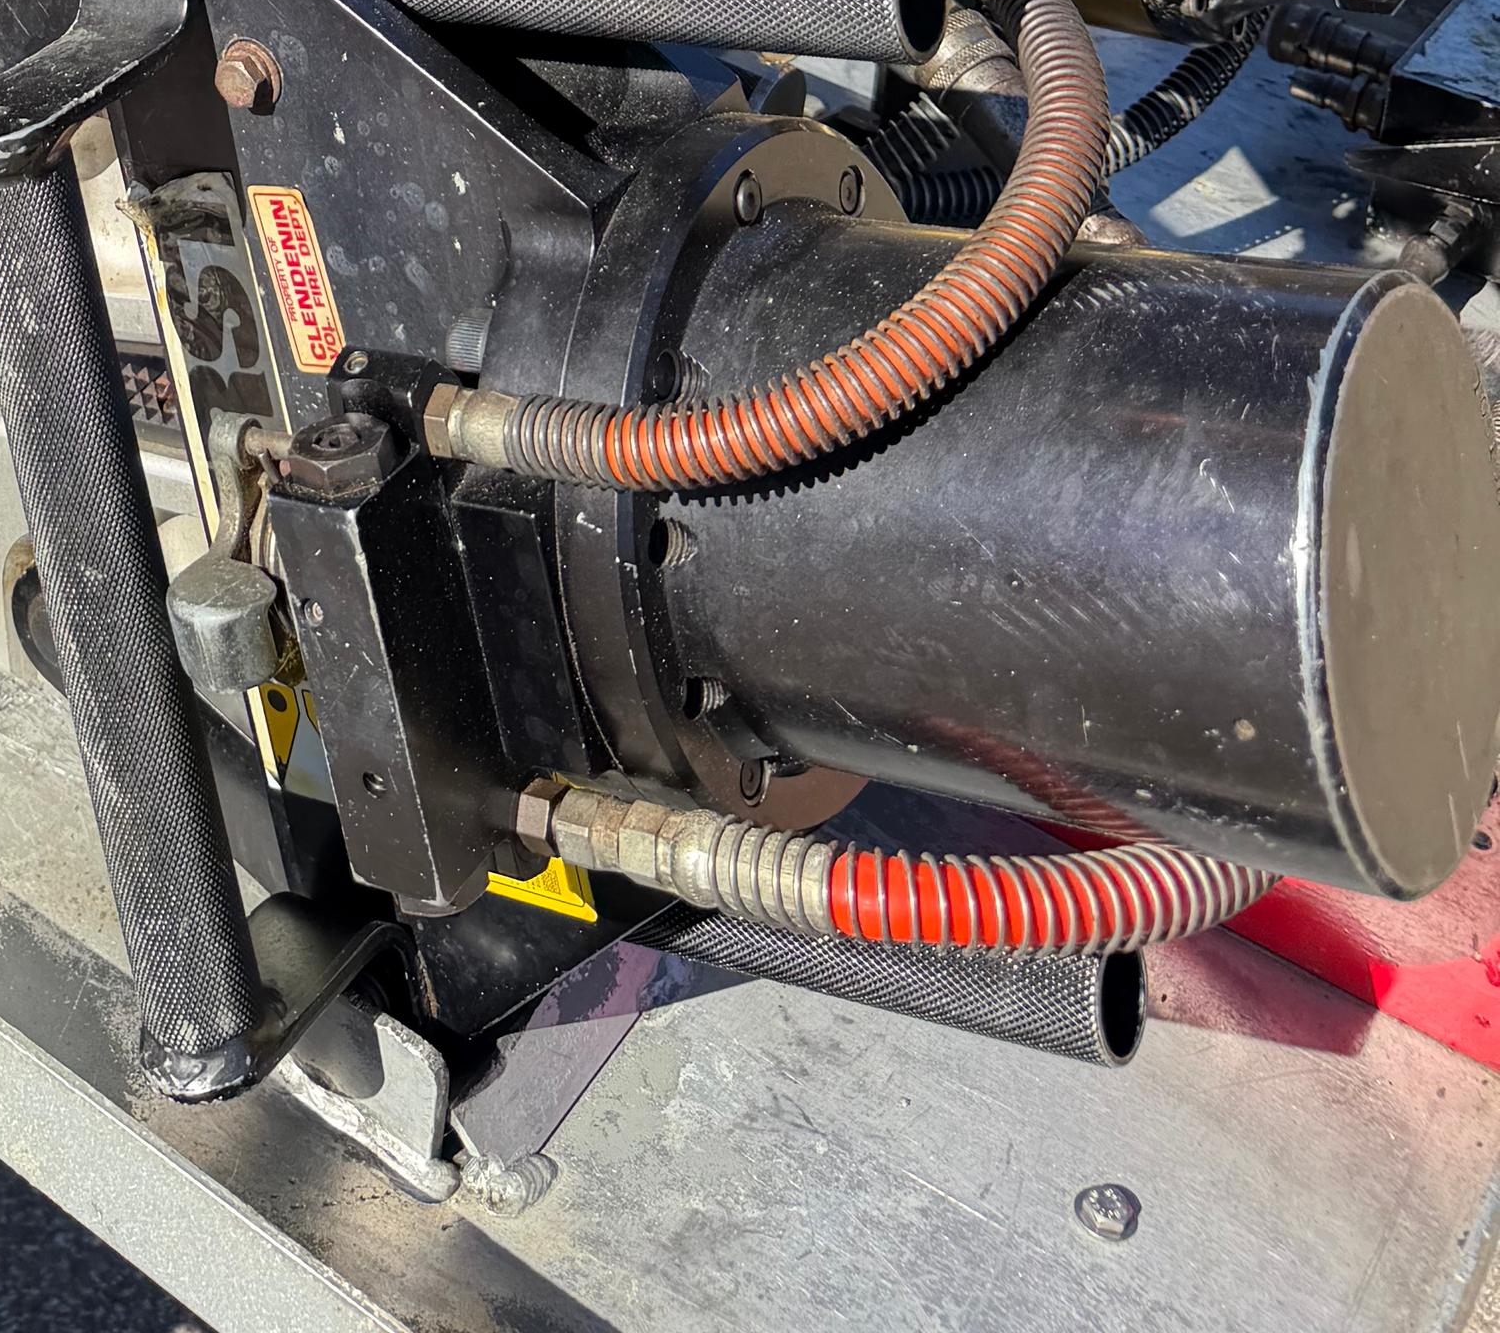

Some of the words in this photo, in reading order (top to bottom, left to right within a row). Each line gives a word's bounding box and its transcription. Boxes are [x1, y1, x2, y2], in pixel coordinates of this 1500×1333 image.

[267, 236, 279, 254] OF
[287, 200, 311, 257] DEPT.
[269, 199, 327, 361] CLENDENIN
[274, 259, 298, 322] PROPERTY
[304, 265, 326, 309] FIRE
